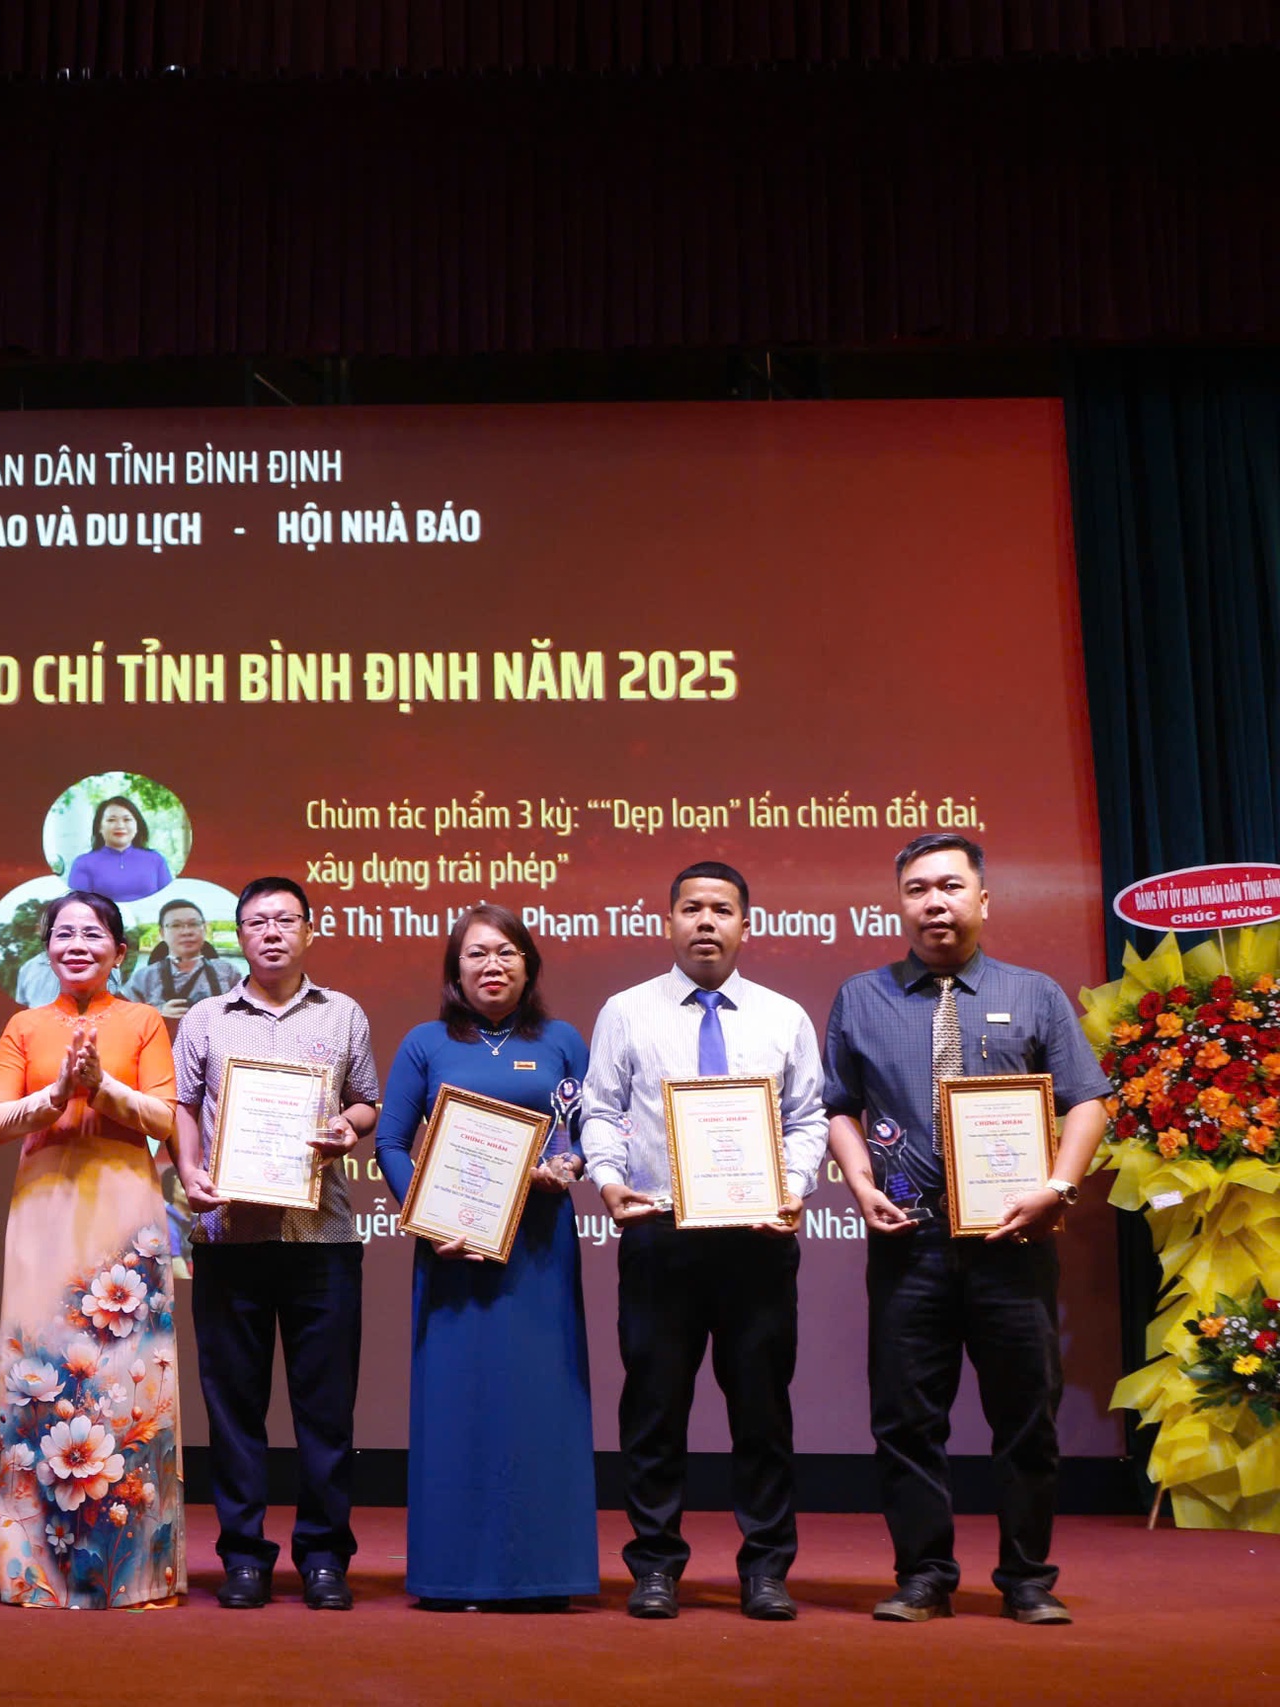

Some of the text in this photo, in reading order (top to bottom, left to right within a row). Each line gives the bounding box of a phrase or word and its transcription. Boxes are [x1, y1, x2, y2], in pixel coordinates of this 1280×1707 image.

[34, 444, 96, 487] DÂN
[104, 441, 176, 485] TỈNH
[185, 442, 259, 485] BÌNH
[266, 449, 342, 489] ĐỊNH
[35, 504, 79, 547] VÀ
[86, 512, 128, 547] DU
[136, 511, 202, 554] LỊCH
[233, 527, 246, 535] -
[278, 501, 333, 552] HỘI
[341, 501, 409, 544] NHÀ
[416, 500, 481, 543] BÁO
[32, 640, 104, 704] CHÍ
[116, 637, 225, 703] TỈNH
[239, 639, 352, 702] BÌNH
[362, 652, 479, 714] ĐỊNH
[493, 638, 605, 701] NĂM
[618, 650, 738, 701] 2025
[306, 798, 380, 829] Chùm
[387, 798, 427, 829] tác
[434, 790, 510, 836] phẩm
[517, 799, 533, 829] 3
[540, 797, 579, 837] kỳ:
[672, 797, 741, 833] loạn”
[748, 790, 790, 828] lấn
[797, 790, 878, 828] chiếm
[885, 790, 929, 828] đất
[936, 796, 986, 836] đai,
[306, 851, 569, 891] xây dựng trái phép”
[1134, 885, 1158, 911] ĐẢNG
[1157, 883, 1169, 909] ỦY
[1169, 882, 1182, 908] ỦY
[1182, 886, 1200, 907] BAN
[1200, 880, 1224, 905] NHÂN
[1224, 879, 1242, 903] DÂN
[1242, 874, 1263, 901] TỈNH
[342, 905, 383, 943] Thị
[388, 905, 439, 937] Thu
[522, 905, 600, 942] Phạm
[604, 898, 663, 938] Tiến
[749, 906, 837, 945] Dương
[849, 902, 903, 937] Văn
[1170, 906, 1273, 925] CHÚC MỪNG
